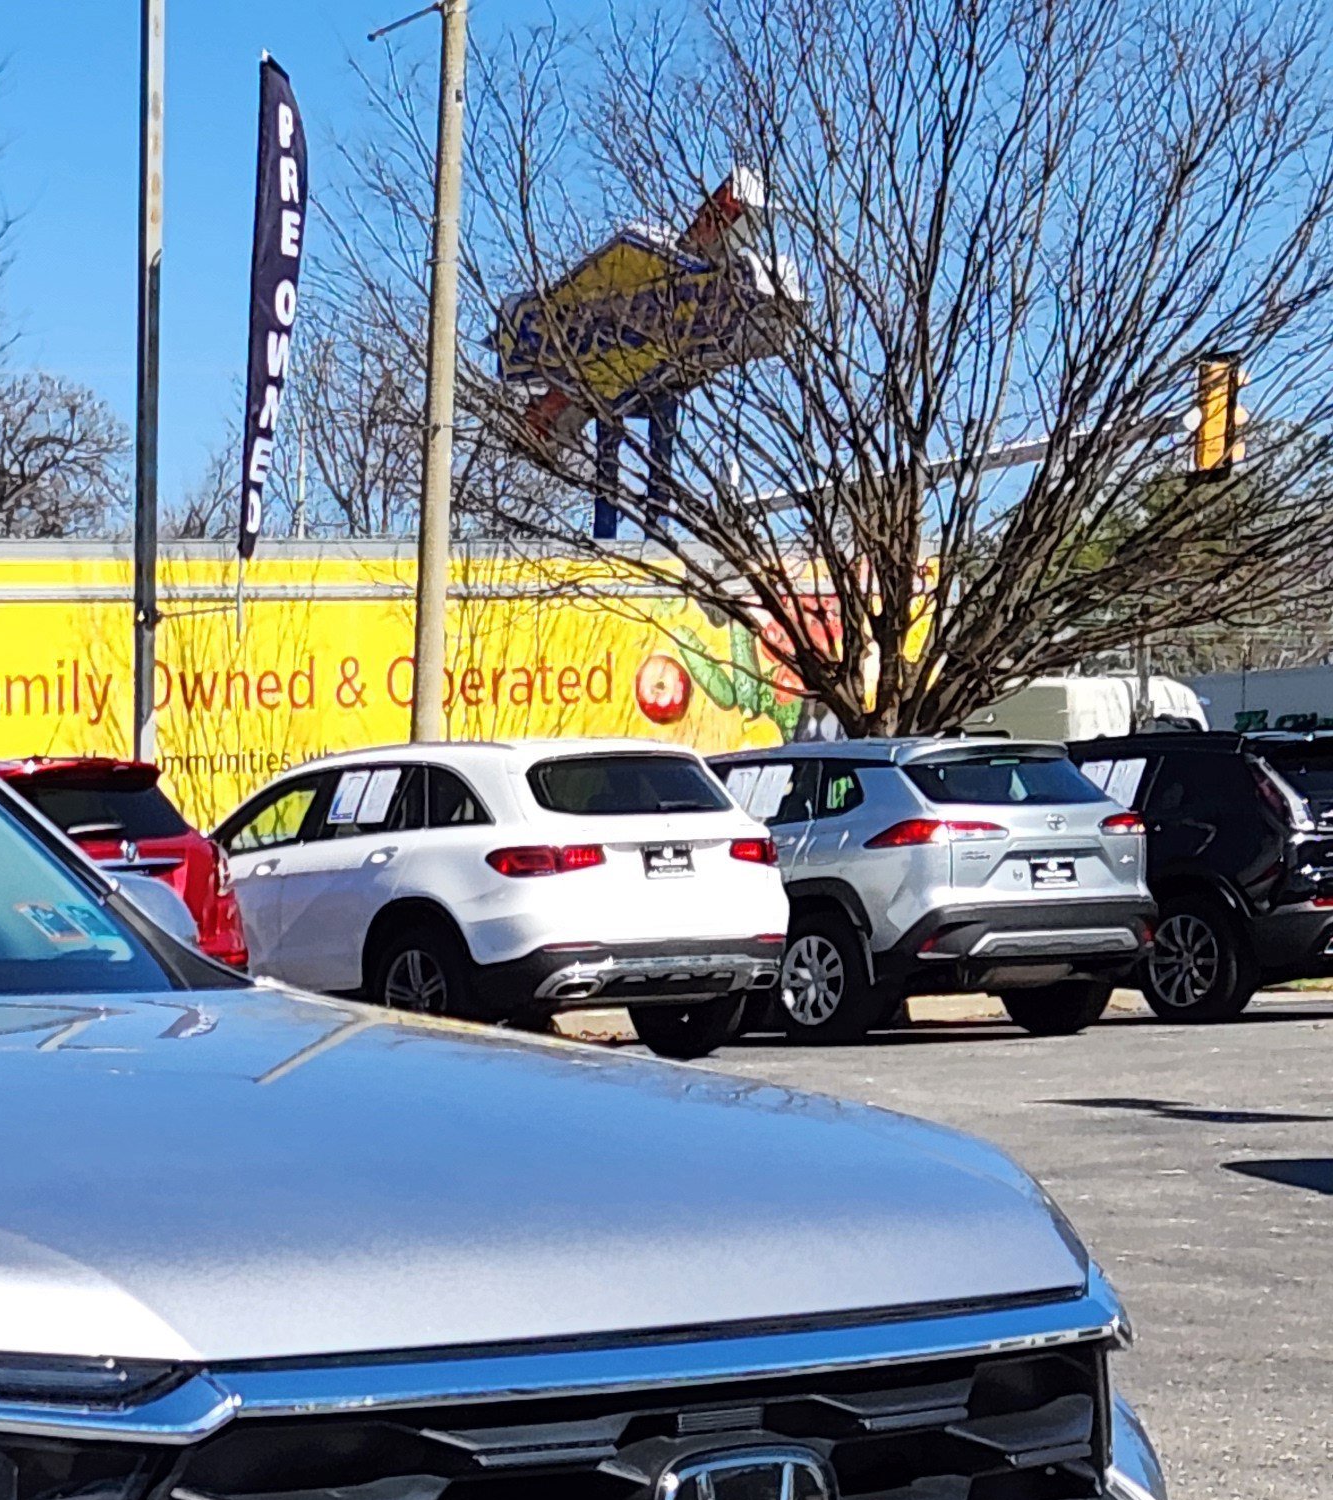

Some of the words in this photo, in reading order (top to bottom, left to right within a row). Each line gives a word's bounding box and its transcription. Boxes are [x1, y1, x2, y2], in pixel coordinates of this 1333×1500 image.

[278, 102, 301, 258] PRE
[245, 279, 297, 534] OWNED
[335, 656, 368, 709] &
[155, 745, 292, 773] mmunities
